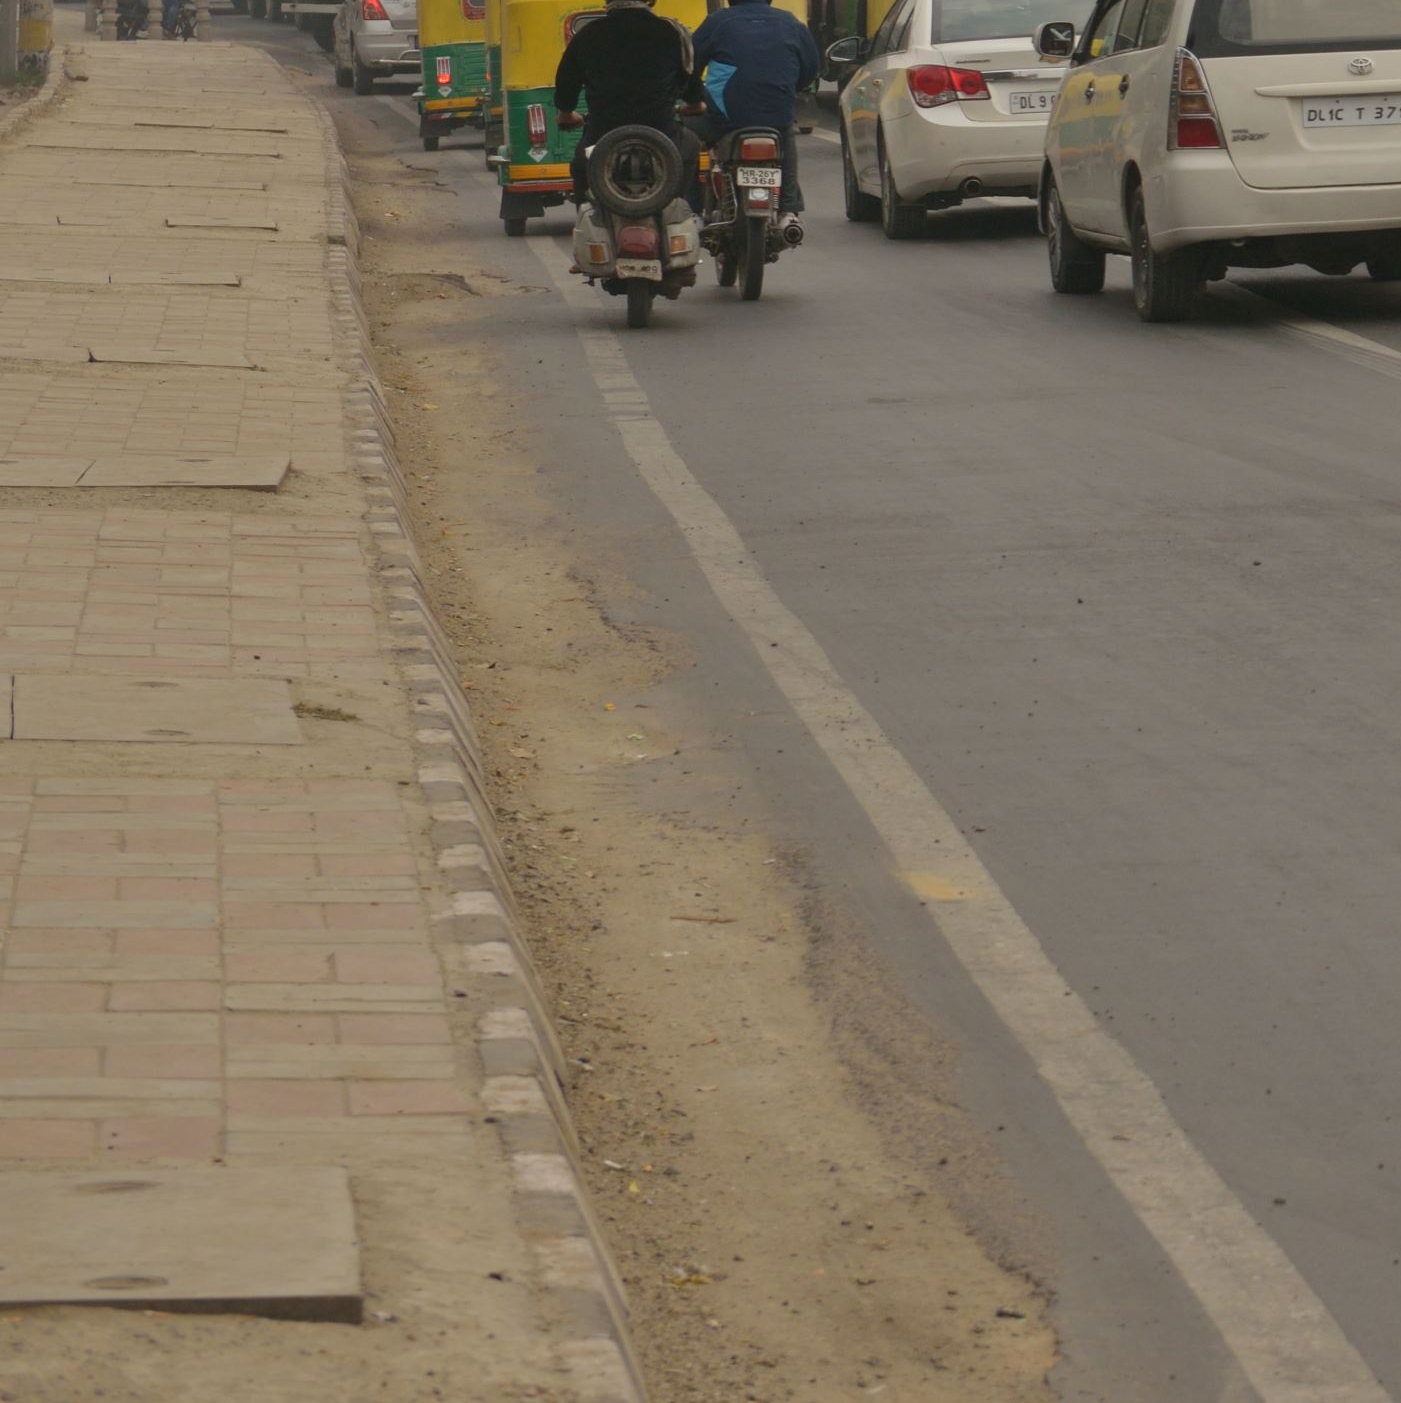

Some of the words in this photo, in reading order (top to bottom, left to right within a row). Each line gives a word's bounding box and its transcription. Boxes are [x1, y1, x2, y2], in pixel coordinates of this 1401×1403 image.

[1020, 96, 1036, 109] DL
[1306, 108, 1344, 122] DL1C
[742, 177, 776, 185] 3368
